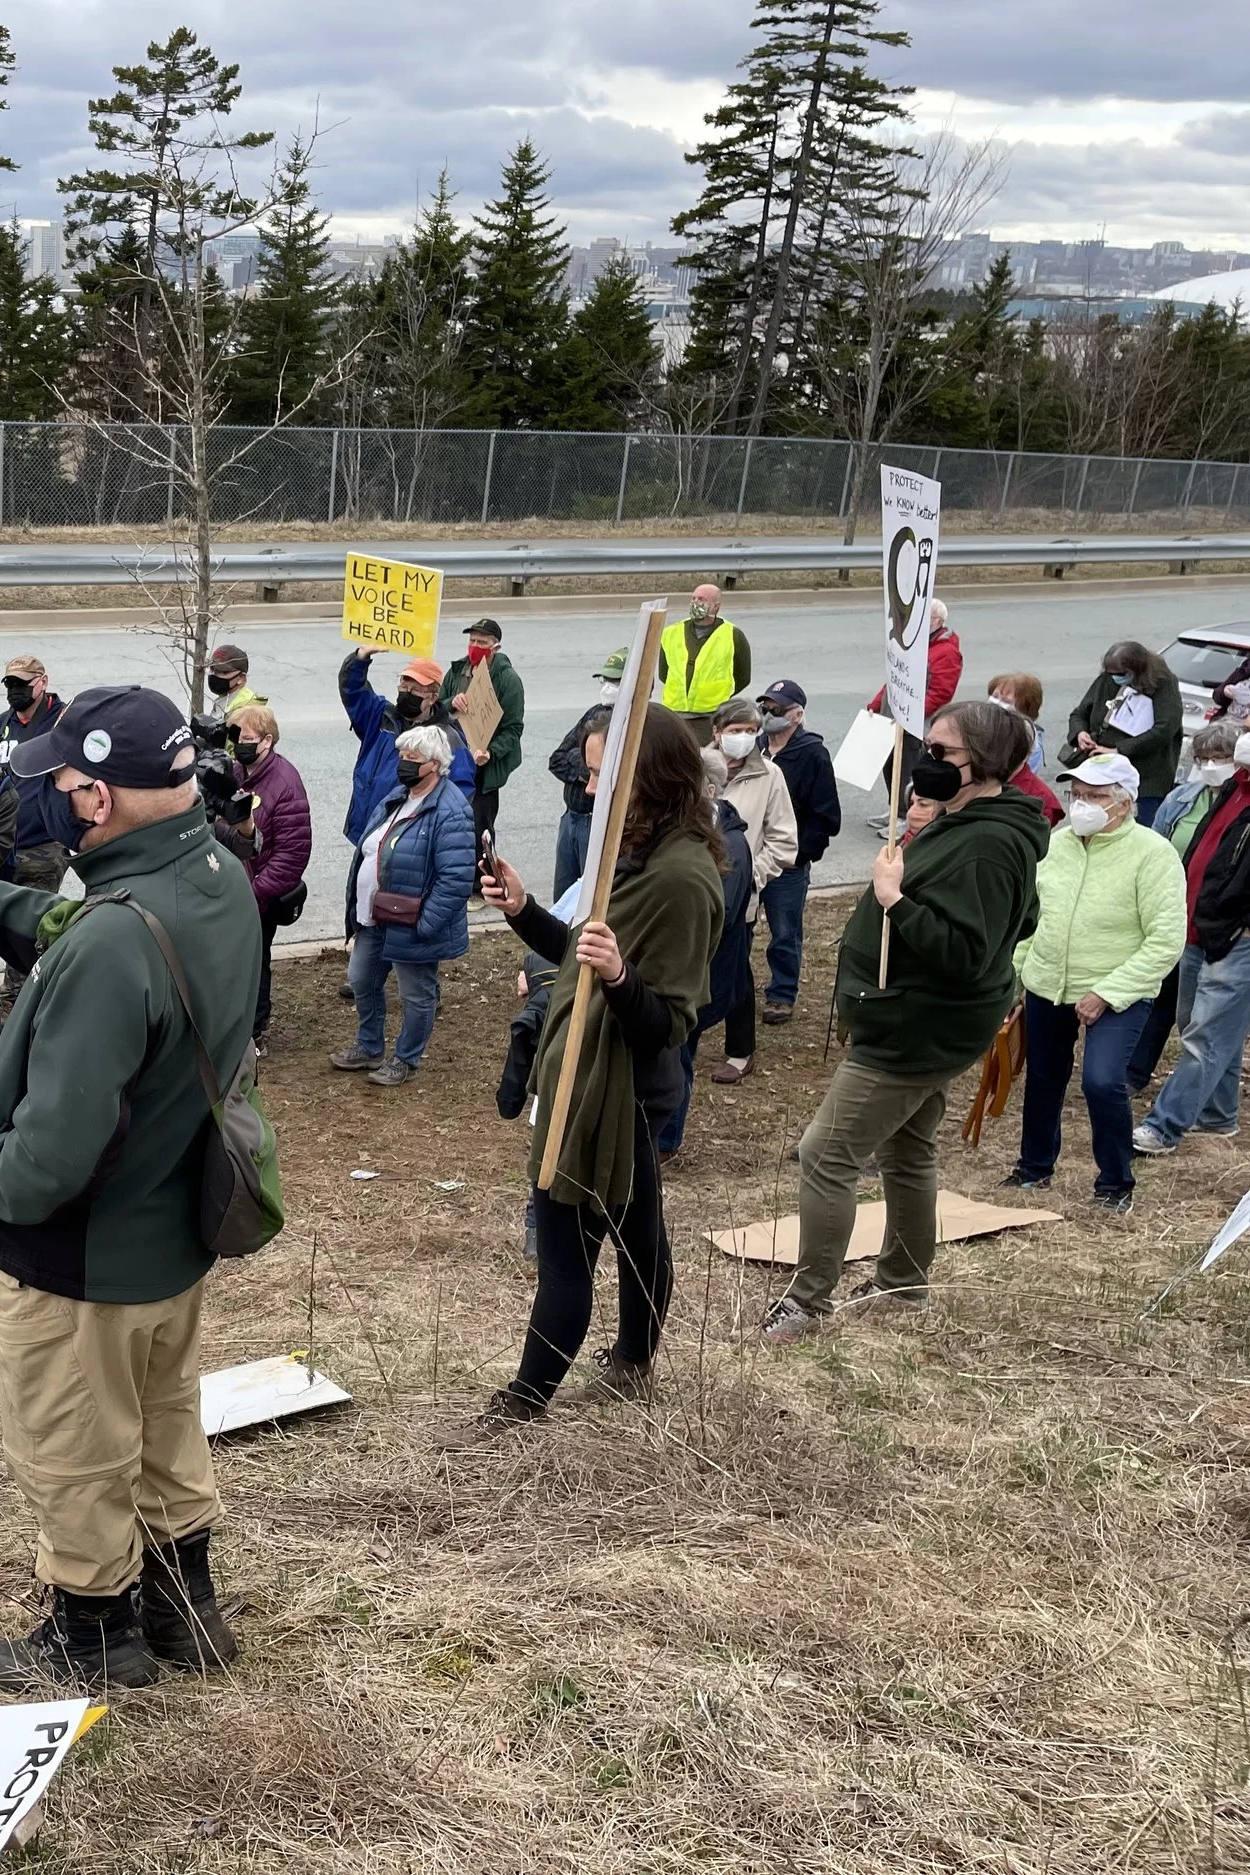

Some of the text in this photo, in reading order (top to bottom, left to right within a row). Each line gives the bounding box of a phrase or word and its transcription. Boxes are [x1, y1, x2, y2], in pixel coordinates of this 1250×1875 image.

[889, 471, 924, 497] PROTECT
[896, 496, 916, 511] KNOW
[352, 560, 435, 592] LET MY
[351, 584, 414, 612] VOICE
[373, 606, 399, 625] BE
[349, 621, 415, 648] HEARD
